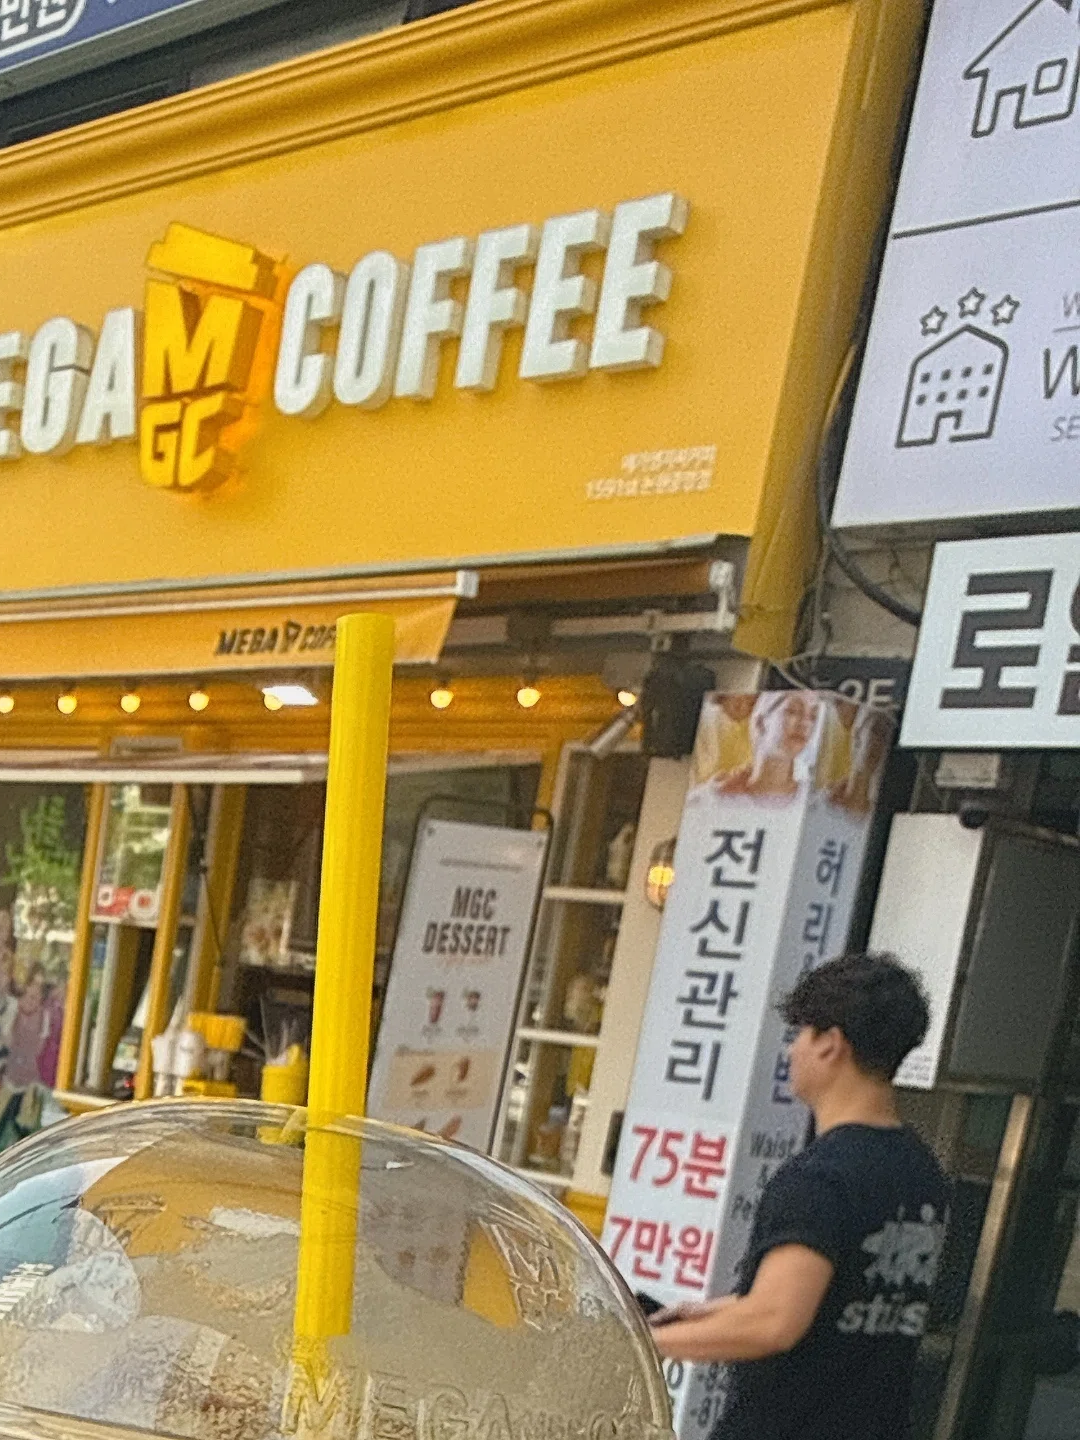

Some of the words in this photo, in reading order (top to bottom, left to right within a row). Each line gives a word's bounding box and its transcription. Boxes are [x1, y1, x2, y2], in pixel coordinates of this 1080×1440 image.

[273, 192, 688, 418] COFFEE
[421, 921, 511, 957] DESSERT
[450, 884, 497, 920] MGC
[664, 828, 767, 1102] 전신관리
[629, 1124, 728, 1200] 75분
[608, 1214, 715, 1291] 7만원
